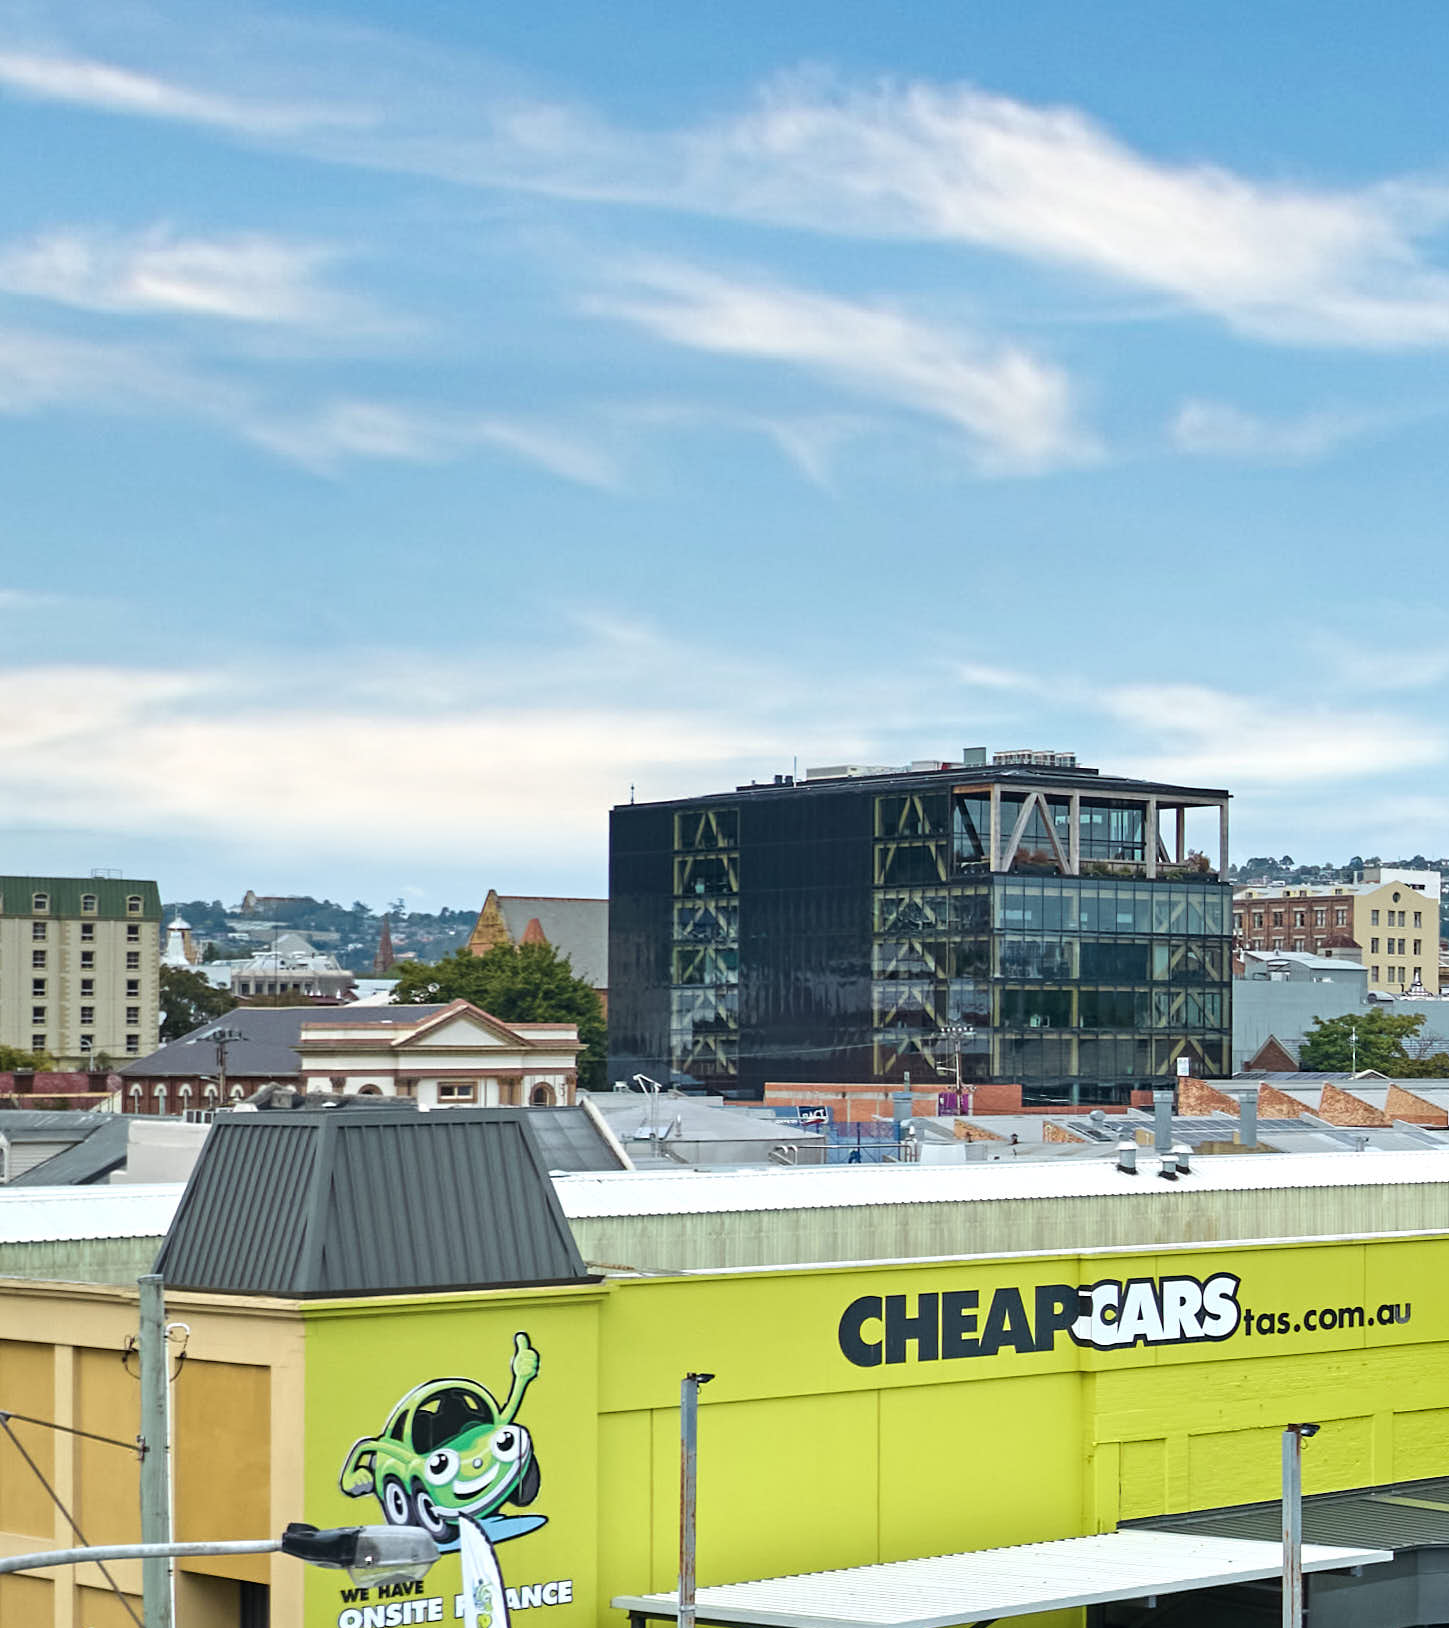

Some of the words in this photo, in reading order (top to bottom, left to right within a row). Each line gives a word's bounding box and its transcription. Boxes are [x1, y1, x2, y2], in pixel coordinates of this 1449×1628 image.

[340, 1587, 369, 1603] WE
[378, 1580, 424, 1599] HAVE
[454, 1579, 573, 1619] FANCE
